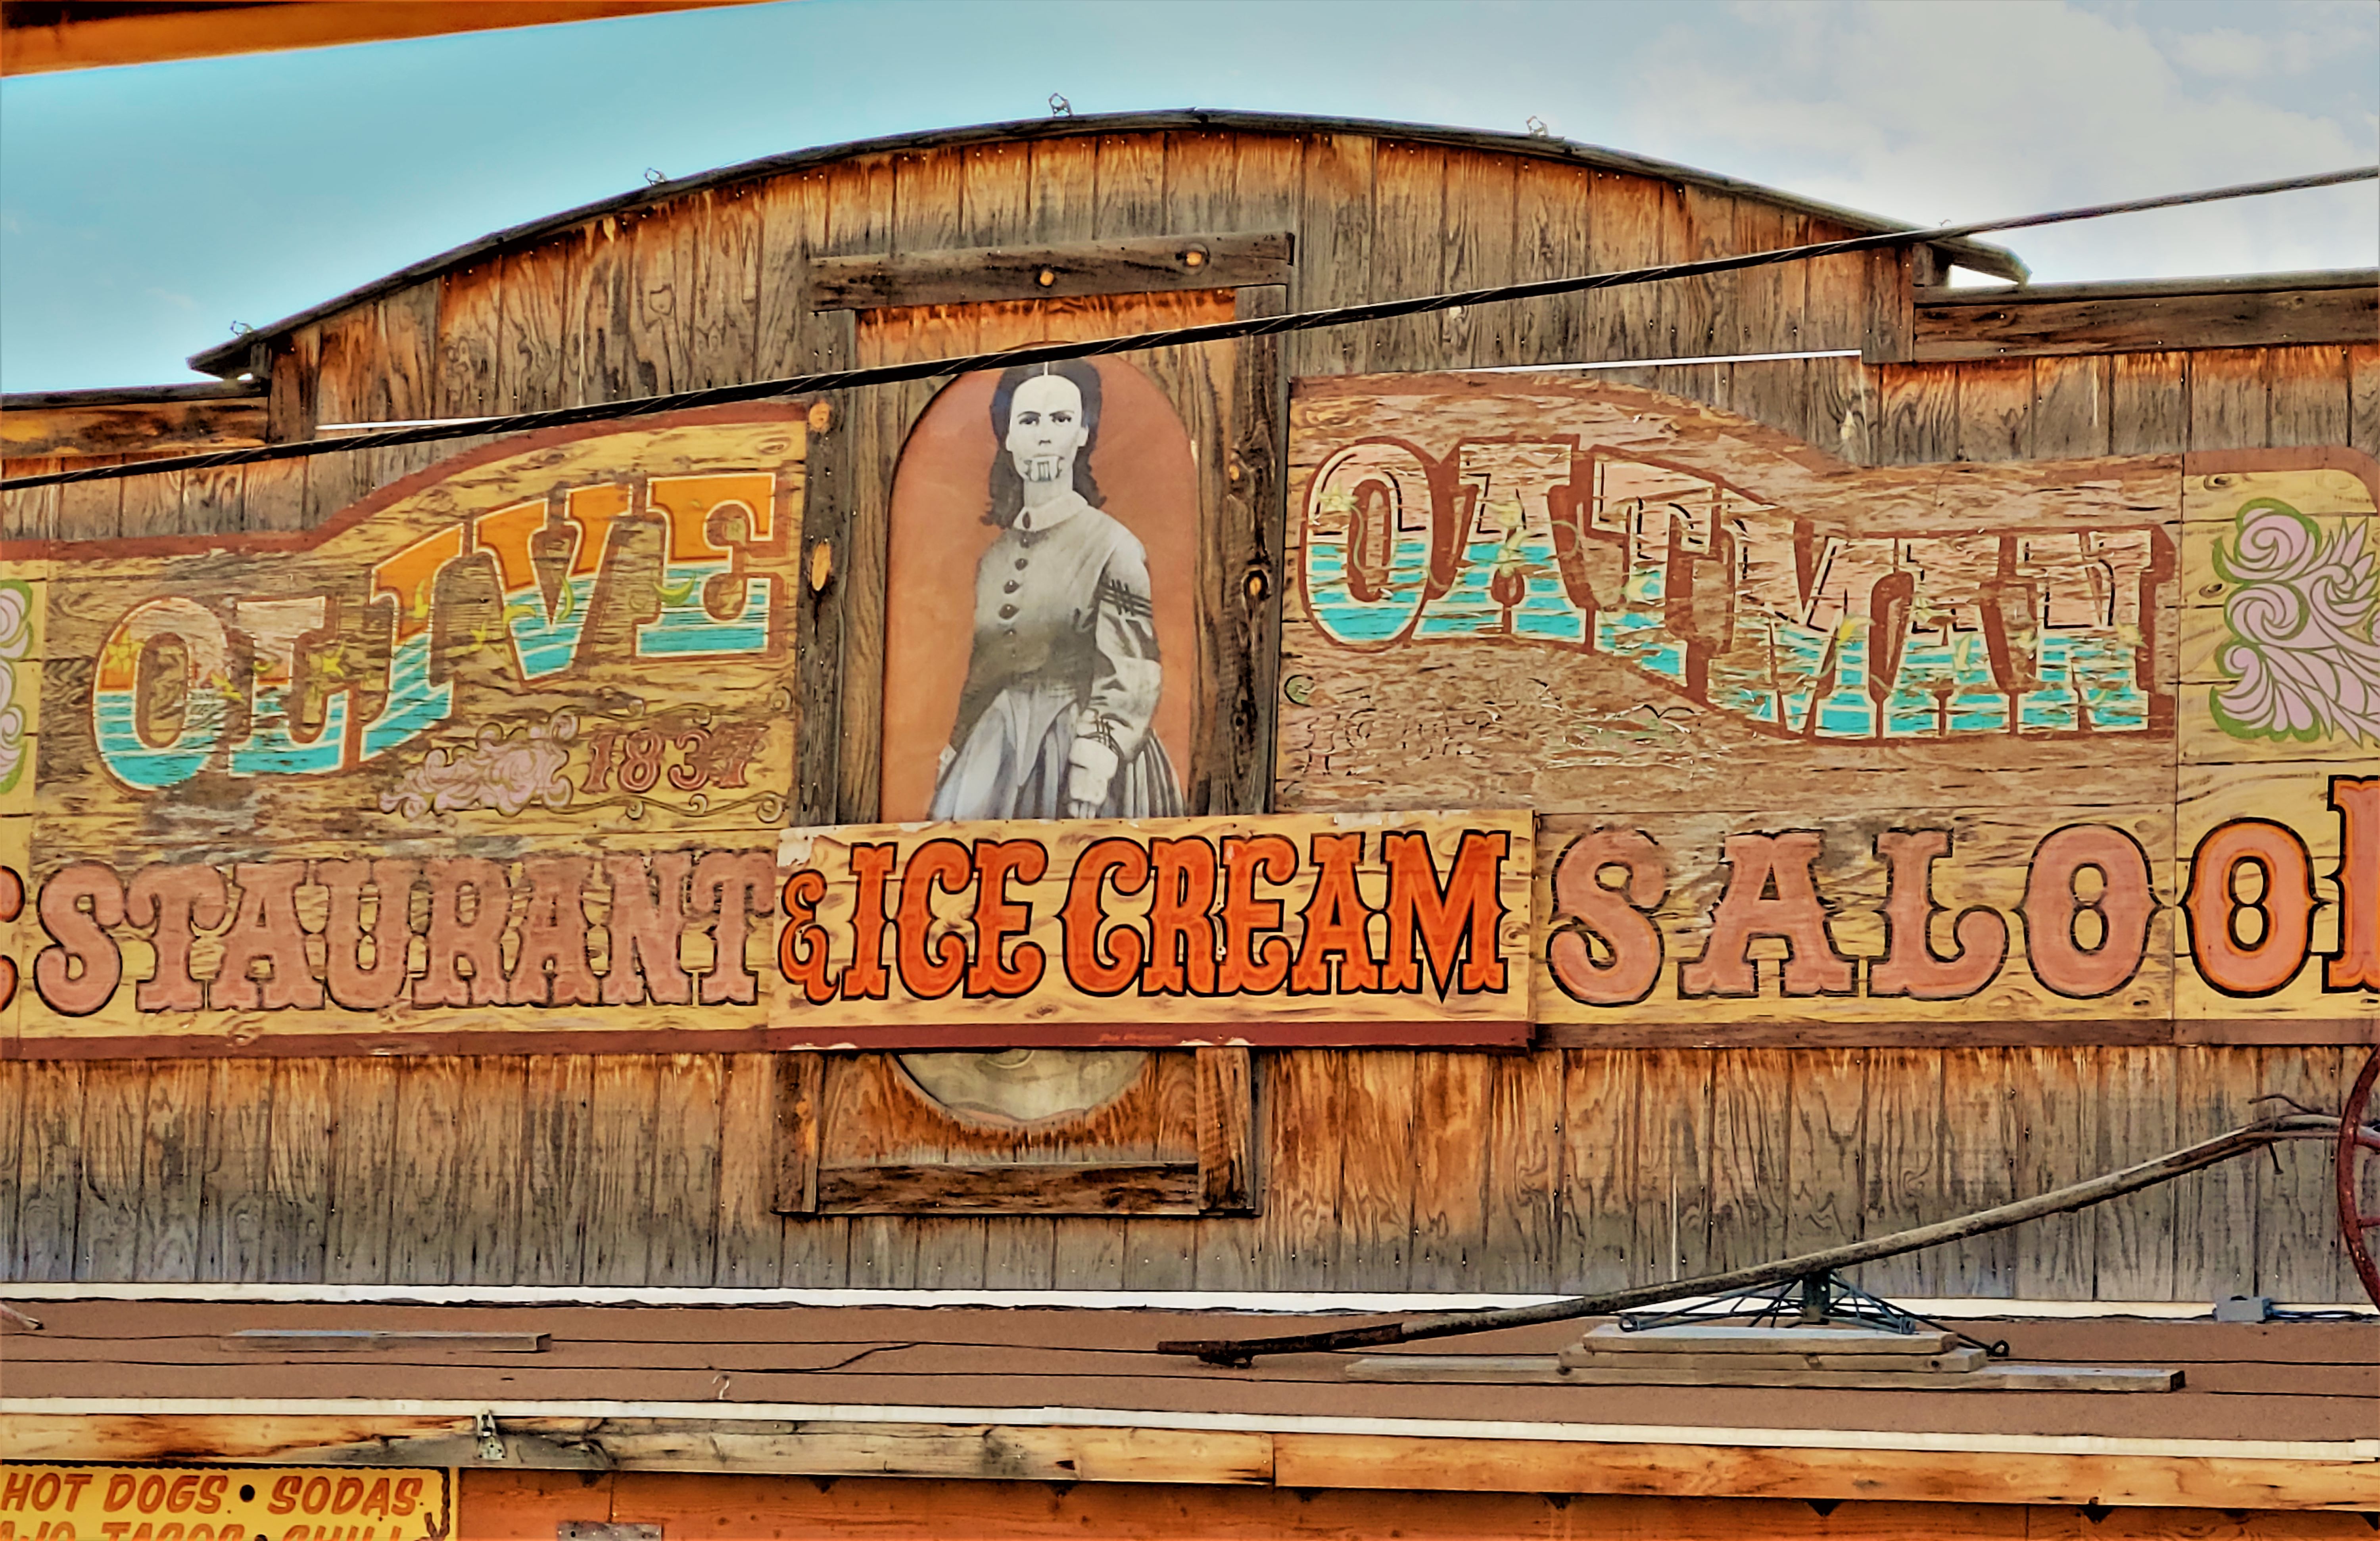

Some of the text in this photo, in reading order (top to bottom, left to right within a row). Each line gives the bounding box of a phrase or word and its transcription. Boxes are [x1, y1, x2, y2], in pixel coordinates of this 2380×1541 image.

[92, 472, 788, 792] OLIVE
[1299, 434, 2175, 745] OATMAN
[780, 830, 1513, 1006] & ICE CREAM
[0, 1472, 424, 1516] HOT DOGS SODAS
